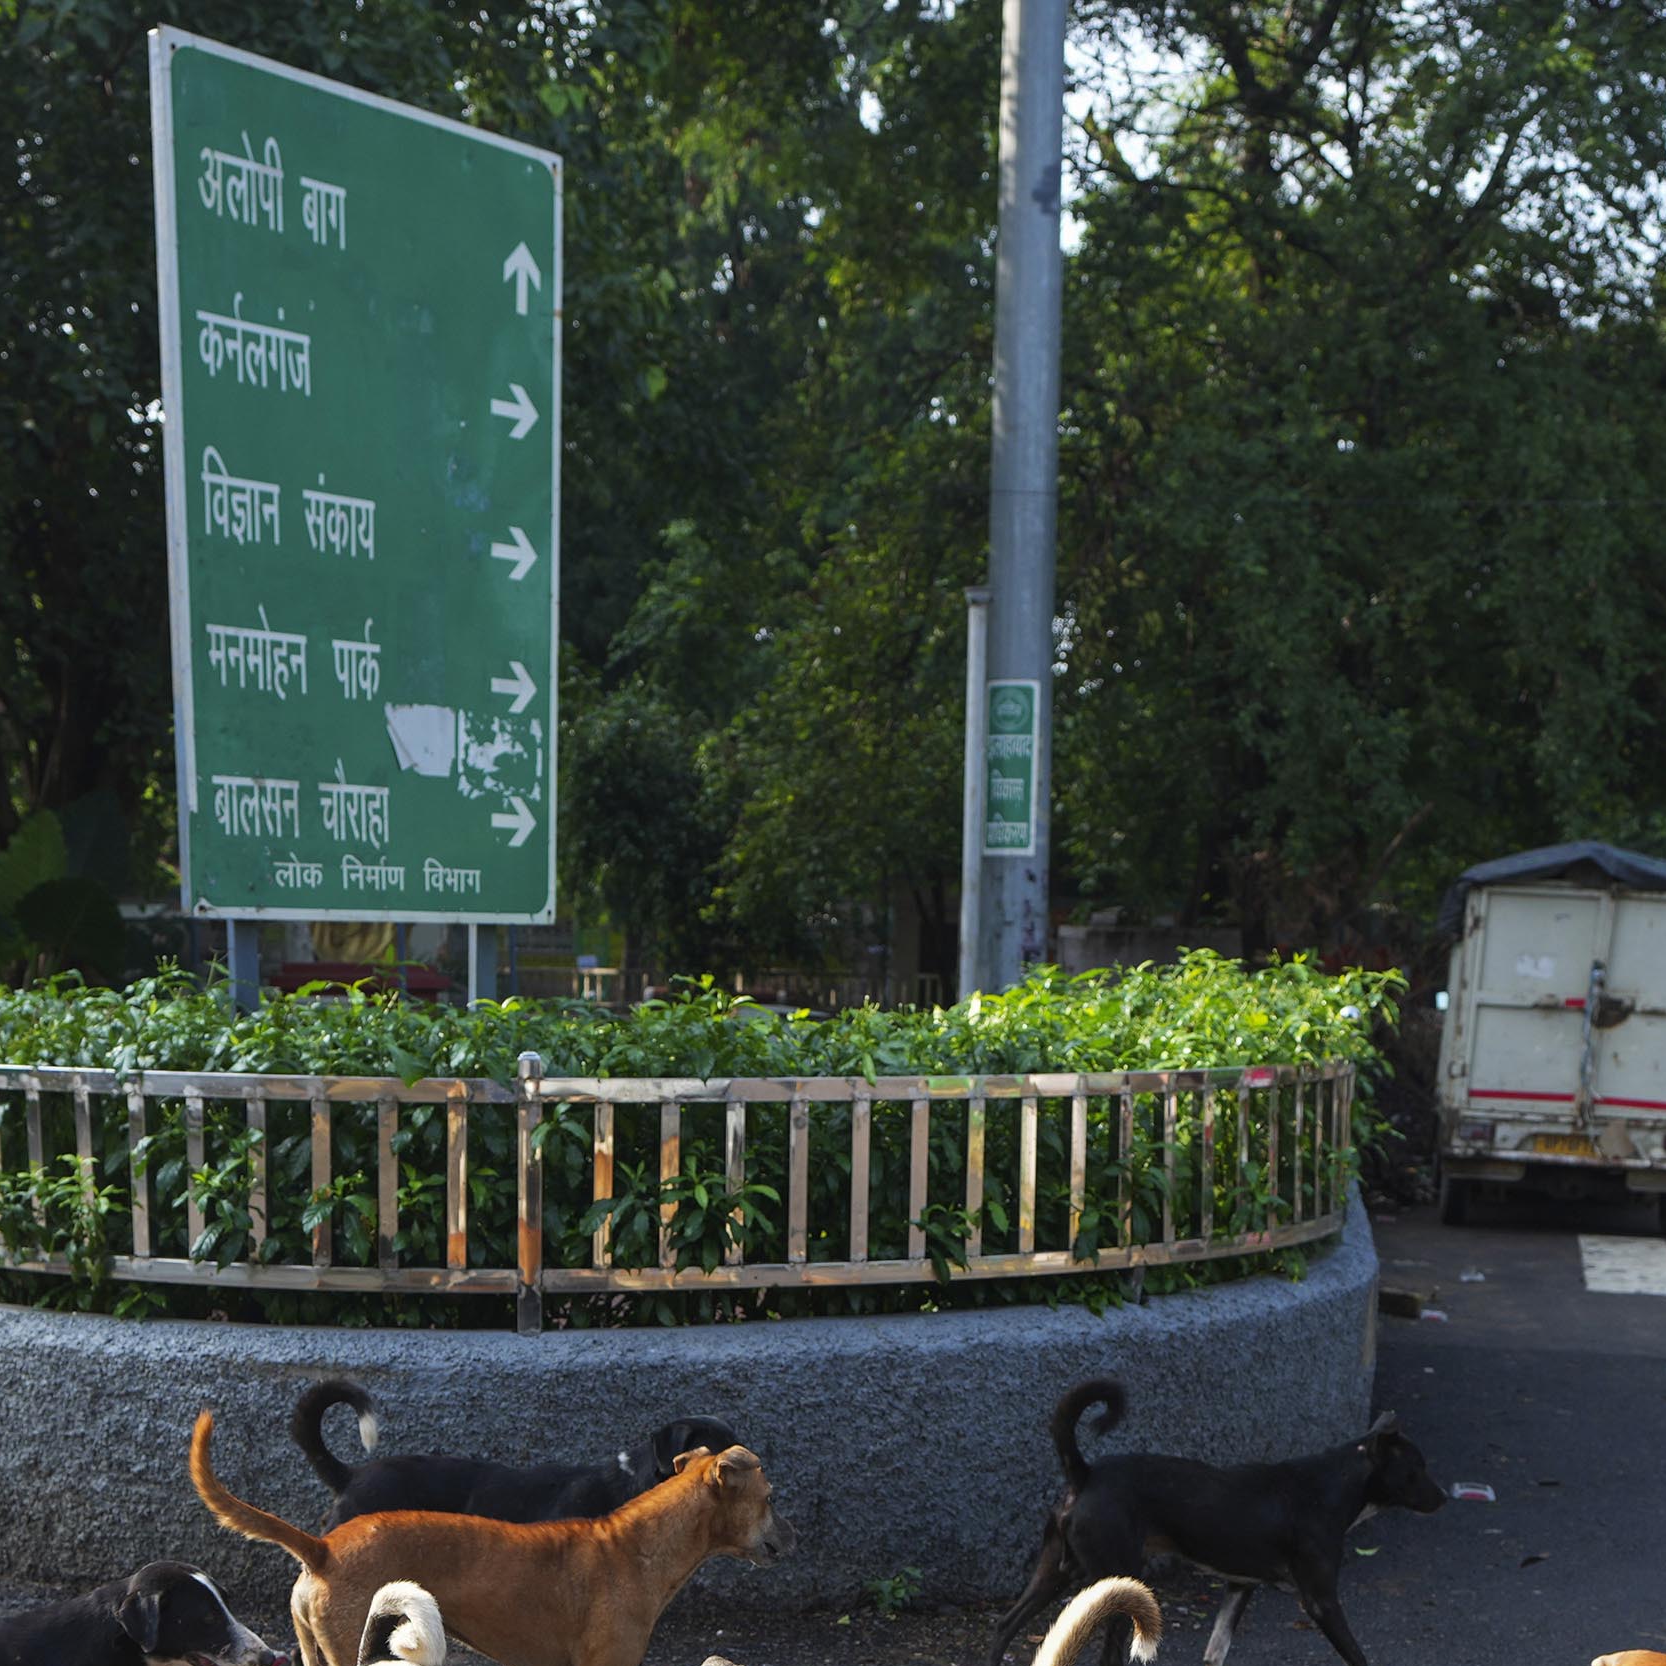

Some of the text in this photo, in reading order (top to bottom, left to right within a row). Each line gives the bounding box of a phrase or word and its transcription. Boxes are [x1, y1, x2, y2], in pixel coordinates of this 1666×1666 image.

[197, 130, 347, 250] अलोपी बाग
[195, 291, 312, 397] कर्नलगंज
[200, 445, 377, 560] विज्ञान संकाय
[205, 603, 381, 701] मनमोहन पार्क
[211, 757, 390, 850] बालसन चौराहा
[273, 851, 481, 894] लोक निर्माण विभाग
